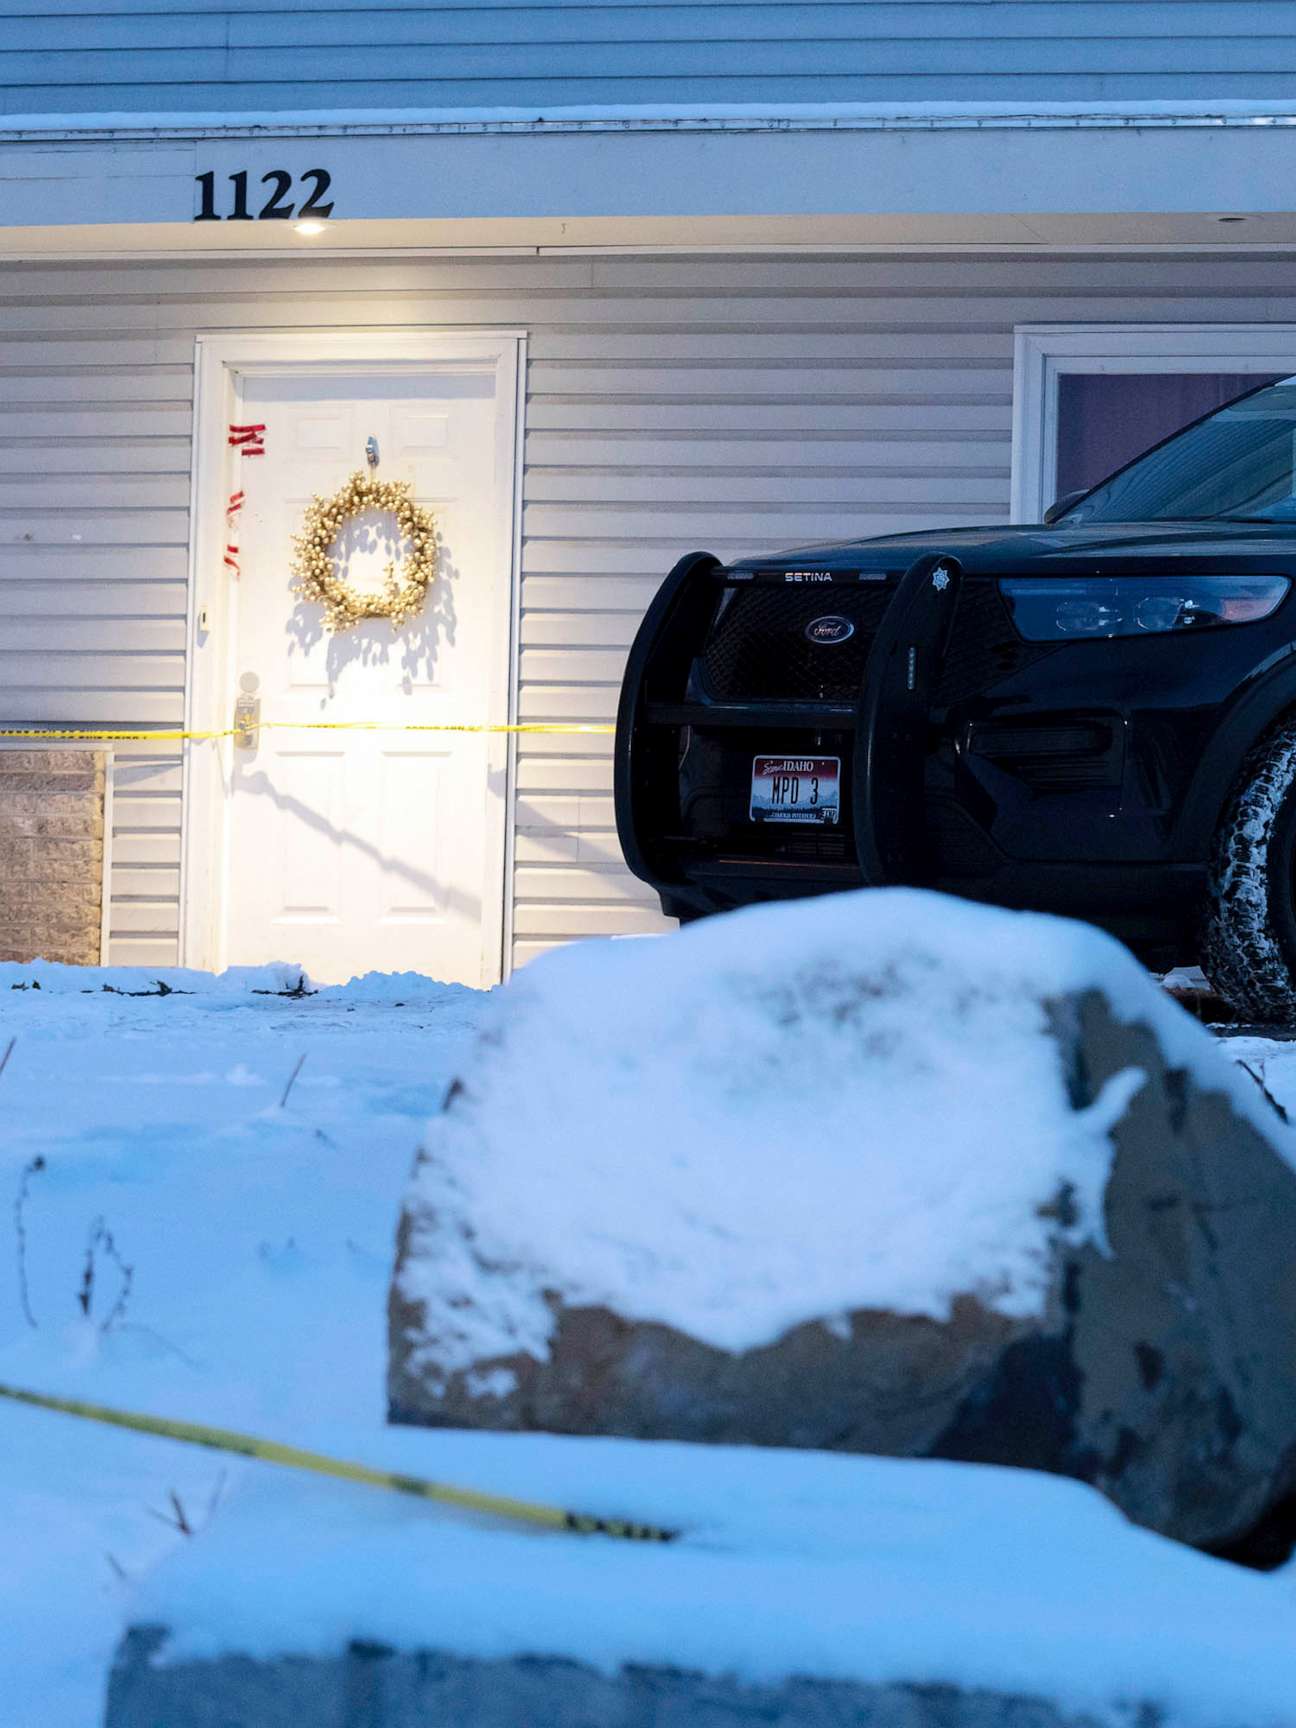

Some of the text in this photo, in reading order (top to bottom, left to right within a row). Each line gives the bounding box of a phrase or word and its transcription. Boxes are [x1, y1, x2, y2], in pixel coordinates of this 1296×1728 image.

[194, 168, 335, 221] 1122
[784, 572, 833, 582] SETINA
[783, 760, 814, 772] IDAHO
[771, 776, 819, 805] MPD 3
